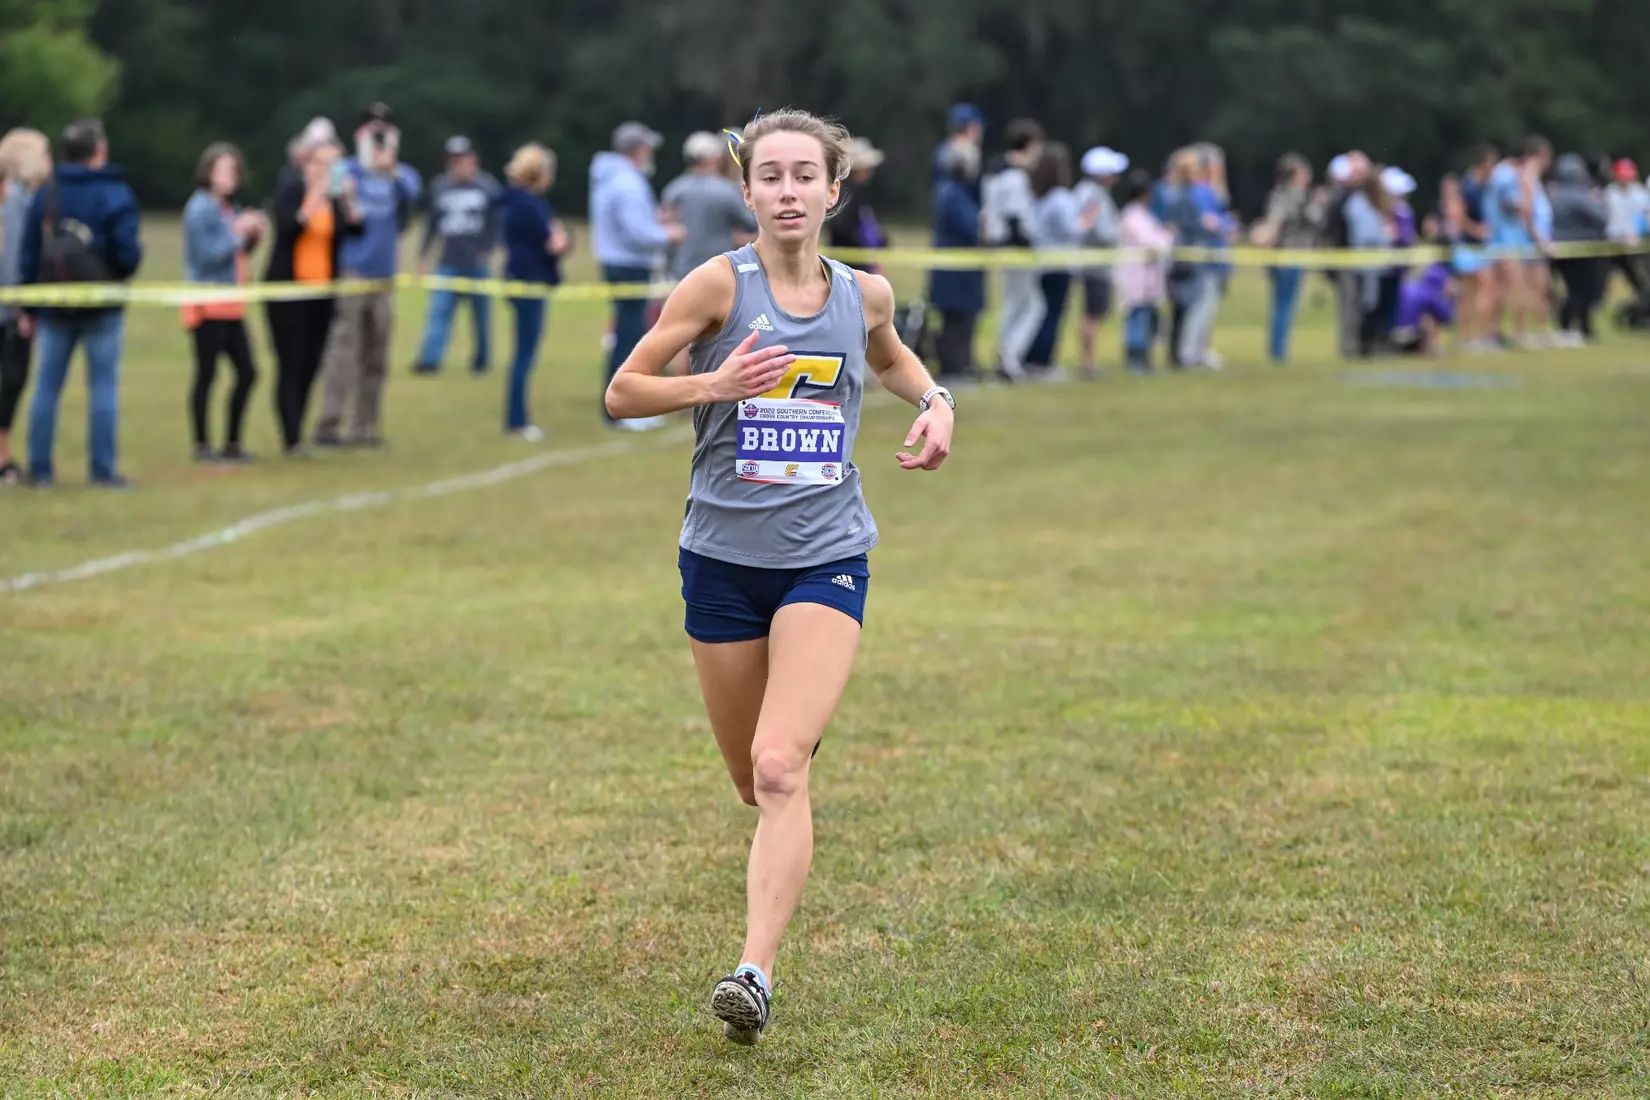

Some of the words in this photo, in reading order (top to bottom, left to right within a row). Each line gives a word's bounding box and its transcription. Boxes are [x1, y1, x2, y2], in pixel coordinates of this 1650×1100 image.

[748, 322, 774, 331] adidas
[776, 407, 807, 415] SOUTHERN
[741, 427, 841, 453] BROWN
[831, 577, 856, 591] adidas
